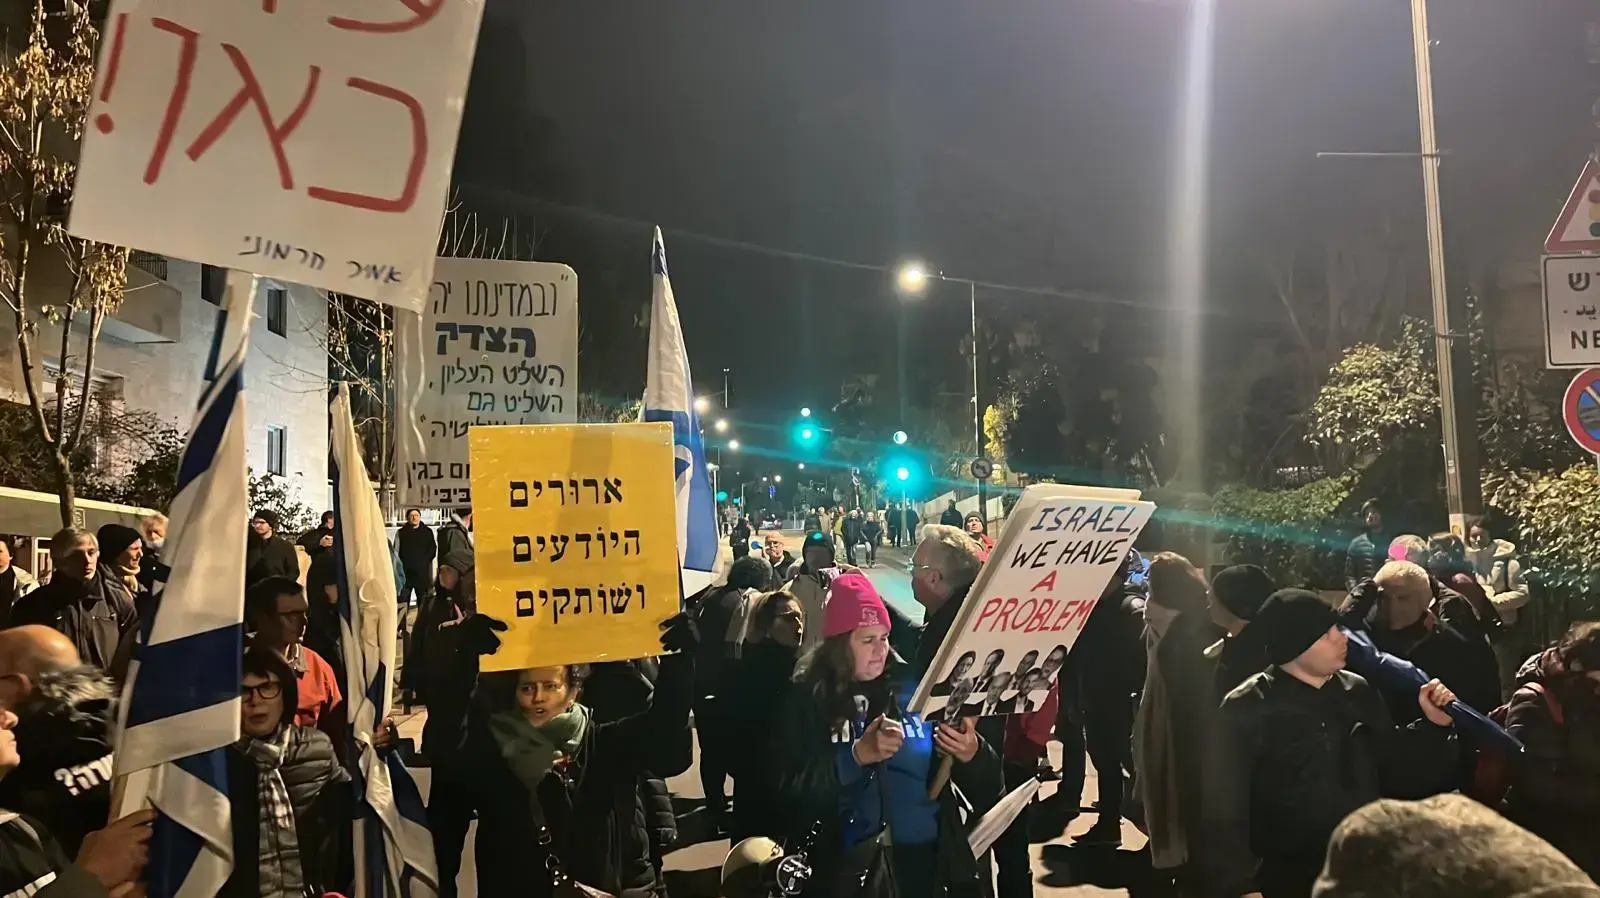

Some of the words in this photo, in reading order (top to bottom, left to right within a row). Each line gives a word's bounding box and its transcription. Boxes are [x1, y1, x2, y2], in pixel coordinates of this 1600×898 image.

[94, 13, 428, 213] כאן!
[1568, 271, 1600, 291] ש
[428, 281, 451, 315] יה
[435, 322, 537, 358] הצדק
[1571, 330, 1600, 349] NE
[503, 360, 565, 388] השליט
[468, 391, 495, 411] גם
[504, 390, 563, 413] השליט
[405, 462, 444, 488] בגין
[1030, 505, 1139, 536] ISRAEL,
[1010, 540, 1057, 569] WE
[1056, 538, 1128, 566] HAVE
[1030, 570, 1057, 592] A
[972, 598, 1094, 634] PROBLEM
